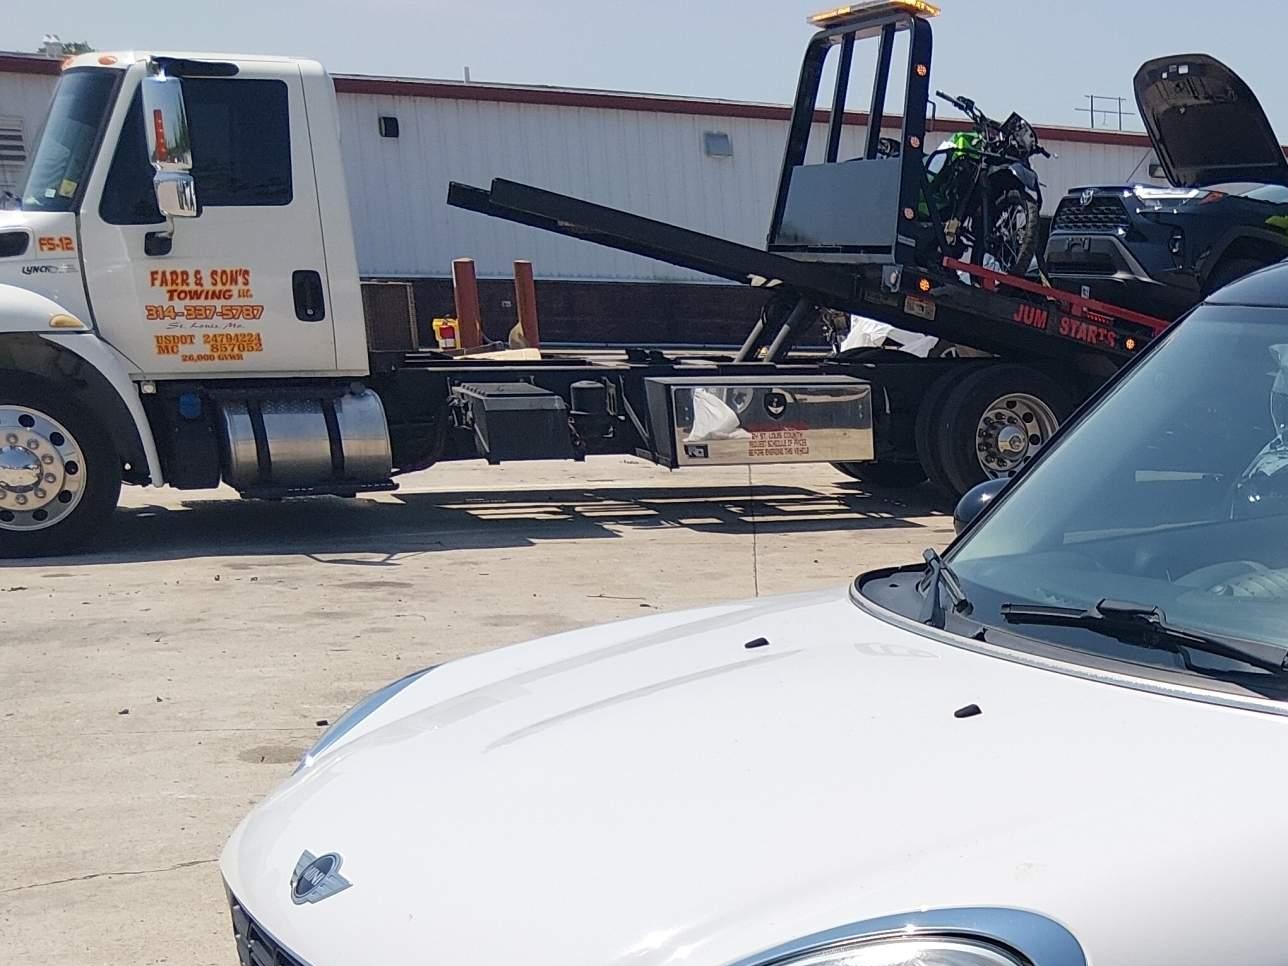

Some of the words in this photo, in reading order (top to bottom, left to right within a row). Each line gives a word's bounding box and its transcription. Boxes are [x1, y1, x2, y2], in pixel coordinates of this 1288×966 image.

[150, 270, 190, 287] FARR
[194, 270, 203, 287] &
[210, 268, 250, 286] SON'S
[166, 289, 233, 301] TOWING
[145, 305, 264, 320] 314-337-5787
[1013, 303, 1048, 329] JUM
[154, 335, 195, 345] USDOT
[156, 345, 180, 355] MC
[210, 343, 263, 353] 857052
[181, 354, 215, 362] 26,000
